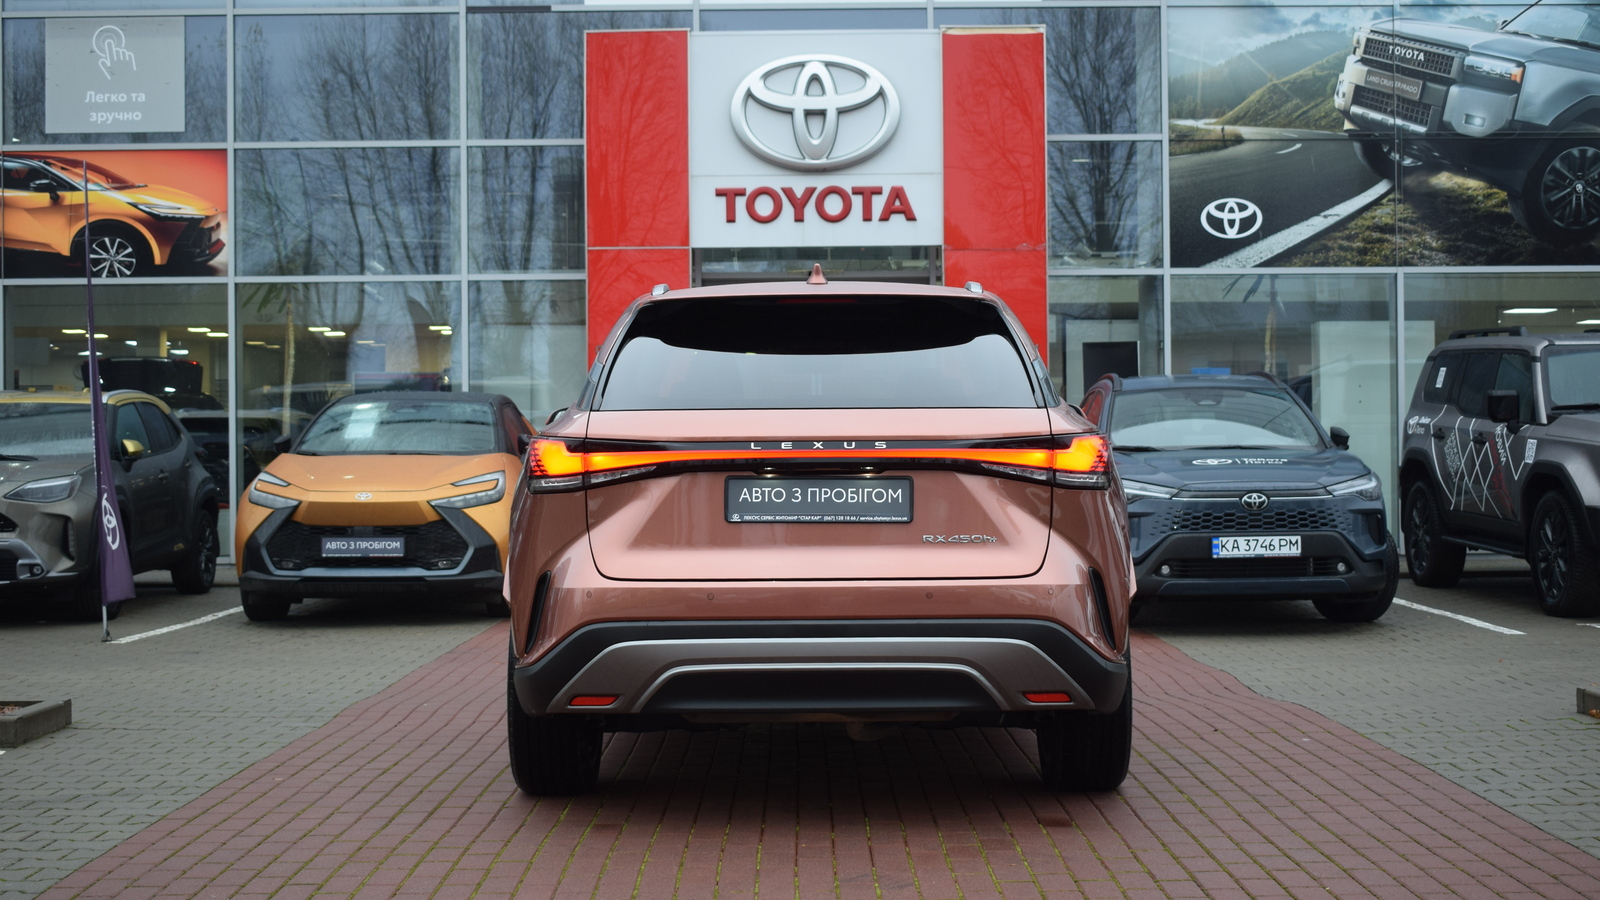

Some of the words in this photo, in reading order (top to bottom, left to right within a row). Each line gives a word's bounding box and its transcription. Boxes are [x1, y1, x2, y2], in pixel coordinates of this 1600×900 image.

[1388, 46, 1424, 61] TOYOTA
[1366, 75, 1379, 83] LAND
[1401, 82, 1418, 93] PRADO
[85, 91, 127, 102] Легко
[130, 92, 146, 102] та
[90, 112, 142, 124] зручно
[716, 186, 917, 223] TOYOTA
[750, 442, 886, 450] LEXUS
[739, 488, 786, 502] АВТО
[808, 488, 902, 503] ПРОБІГОМ
[1220, 539, 1240, 552] KA
[1244, 538, 1276, 552] 3746
[1278, 538, 1298, 551] PM
